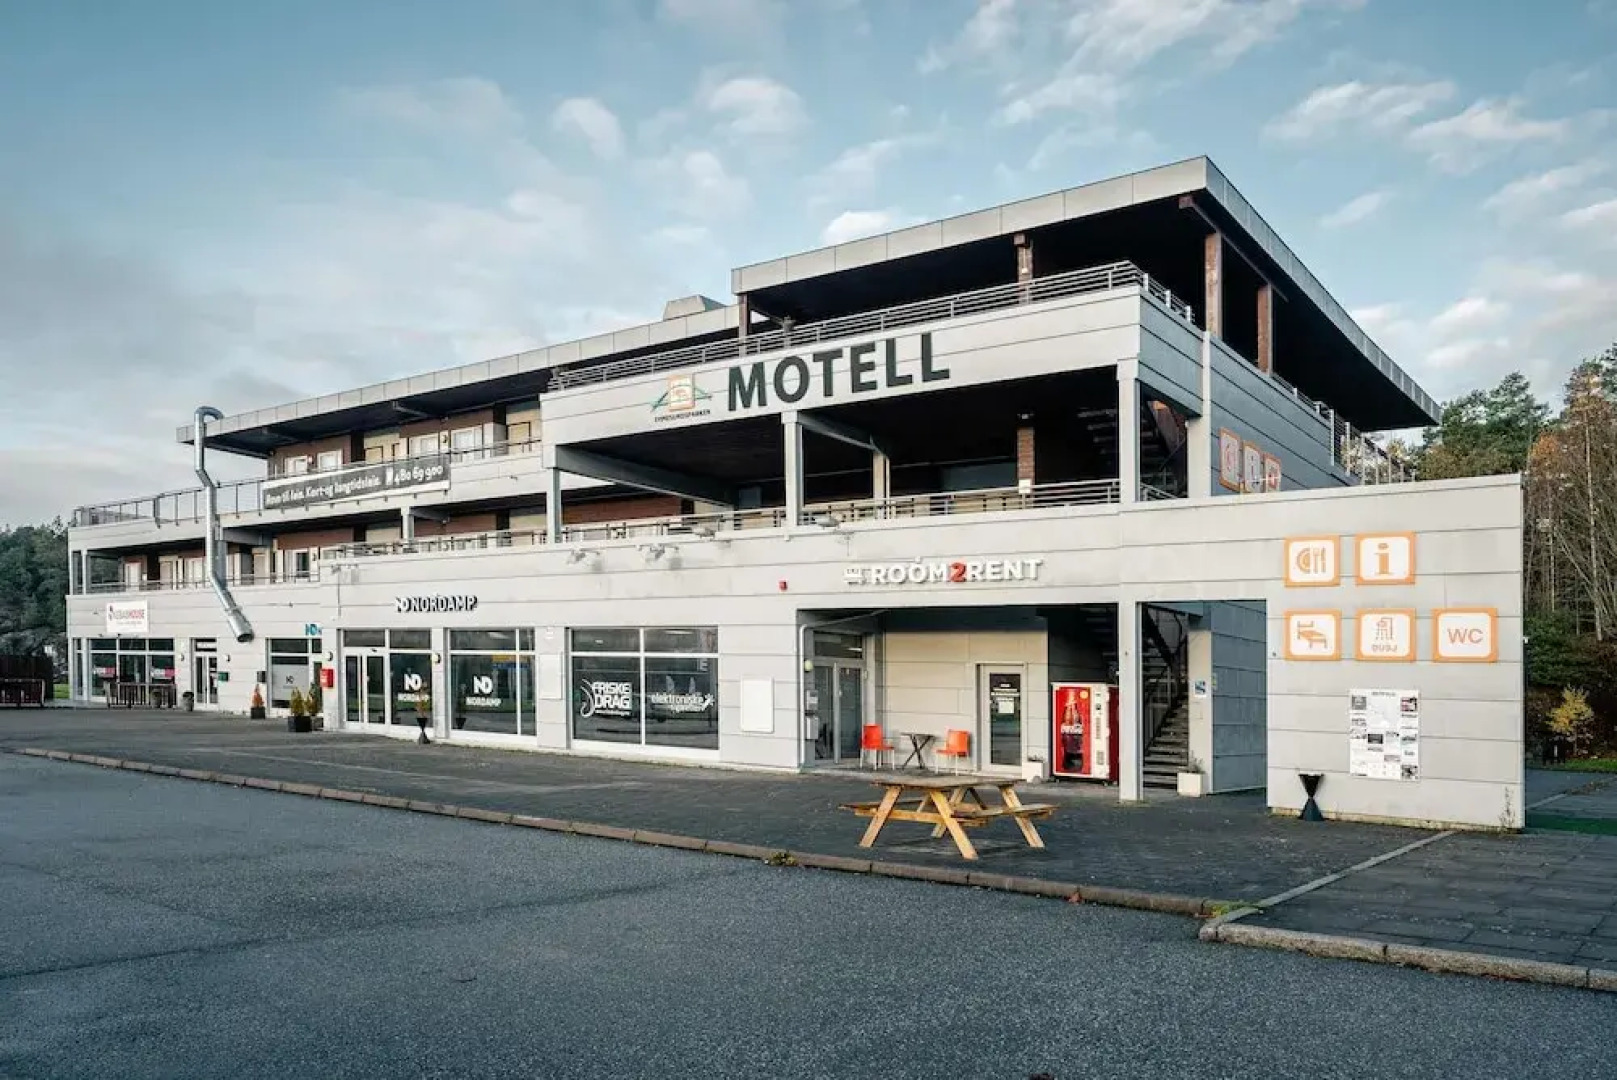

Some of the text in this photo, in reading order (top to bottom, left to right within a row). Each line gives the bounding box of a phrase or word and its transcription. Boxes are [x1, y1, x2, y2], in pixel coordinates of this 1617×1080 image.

[728, 332, 950, 412] MOTELL
[412, 595, 478, 613] NORDAMP
[1447, 628, 1484, 644] WC
[1371, 644, 1398, 652] DUSJ
[473, 675, 493, 694] ND
[592, 681, 632, 695] FRISKE
[594, 694, 632, 709] DRAG
[651, 692, 704, 704] elektroniske
